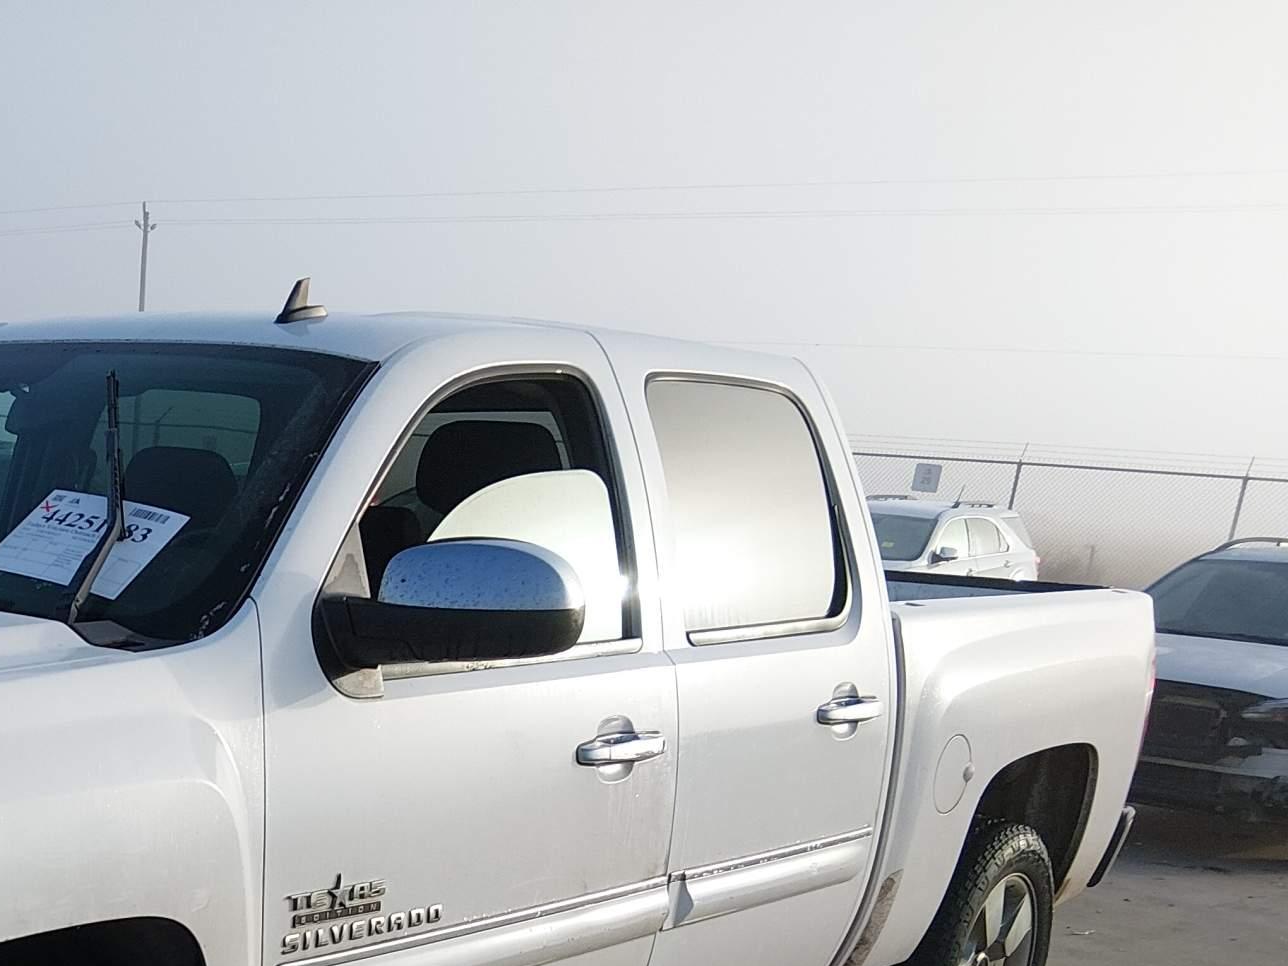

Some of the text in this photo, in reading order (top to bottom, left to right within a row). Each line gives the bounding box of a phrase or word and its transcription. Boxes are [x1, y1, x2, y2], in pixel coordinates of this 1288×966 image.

[41, 509, 152, 543] 4425183
[284, 872, 387, 911] TEXAS
[281, 903, 443, 955] SILVERADO
[291, 900, 381, 928] EDITION
